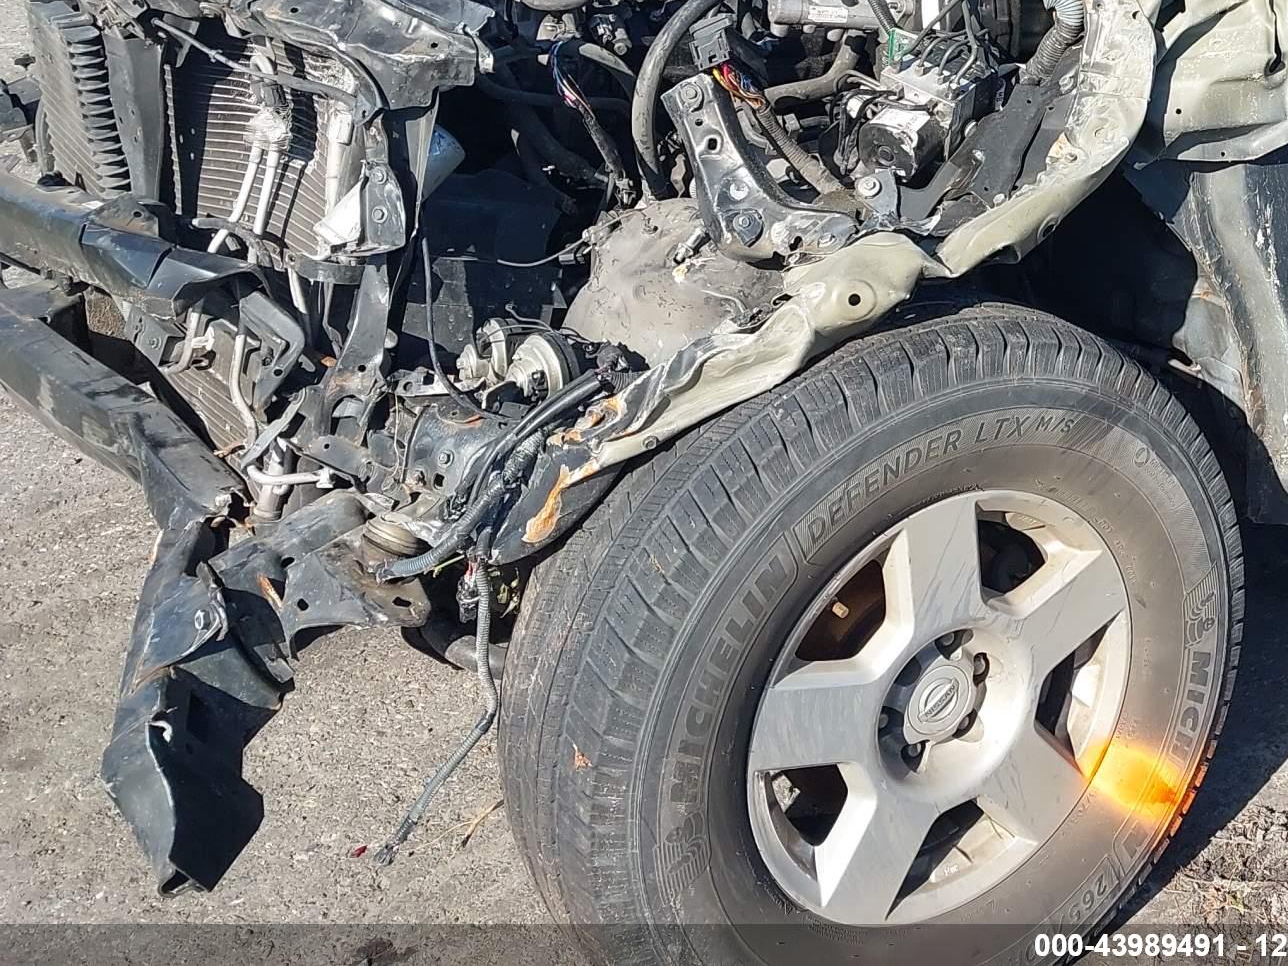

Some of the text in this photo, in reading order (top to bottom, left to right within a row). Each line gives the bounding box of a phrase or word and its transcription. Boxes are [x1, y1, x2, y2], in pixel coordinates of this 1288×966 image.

[808, 415, 1075, 543] DEFENDER LTX M/S
[669, 554, 788, 803] MICHELIN
[924, 681, 956, 717] NISSAN
